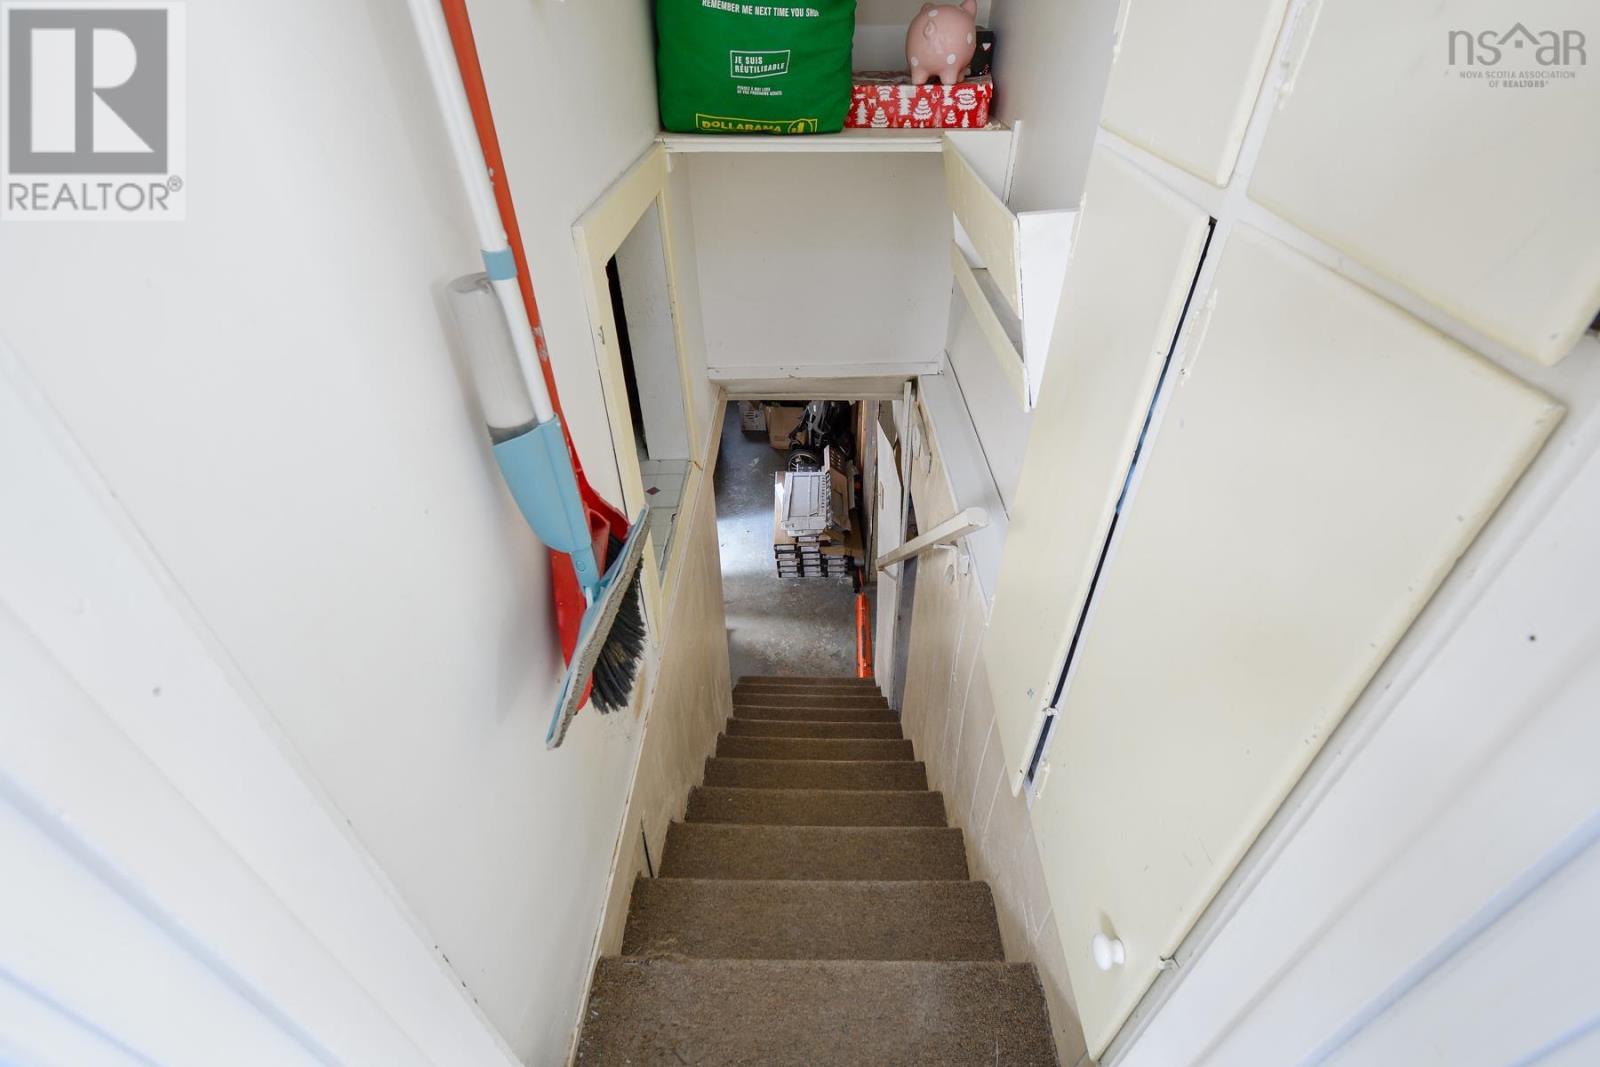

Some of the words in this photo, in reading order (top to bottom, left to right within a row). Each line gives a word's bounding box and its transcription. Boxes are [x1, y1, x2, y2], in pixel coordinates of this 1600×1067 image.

[742, 4, 753, 15] ME
[755, 6, 772, 17] NEXT
[773, 7, 790, 17] TIME
[791, 8, 804, 17] YOU
[735, 56, 743, 64] JE
[745, 56, 763, 65] SUIS
[735, 62, 785, 73] RÉUTILISABLE
[702, 121, 781, 132] DOLLARAMA
